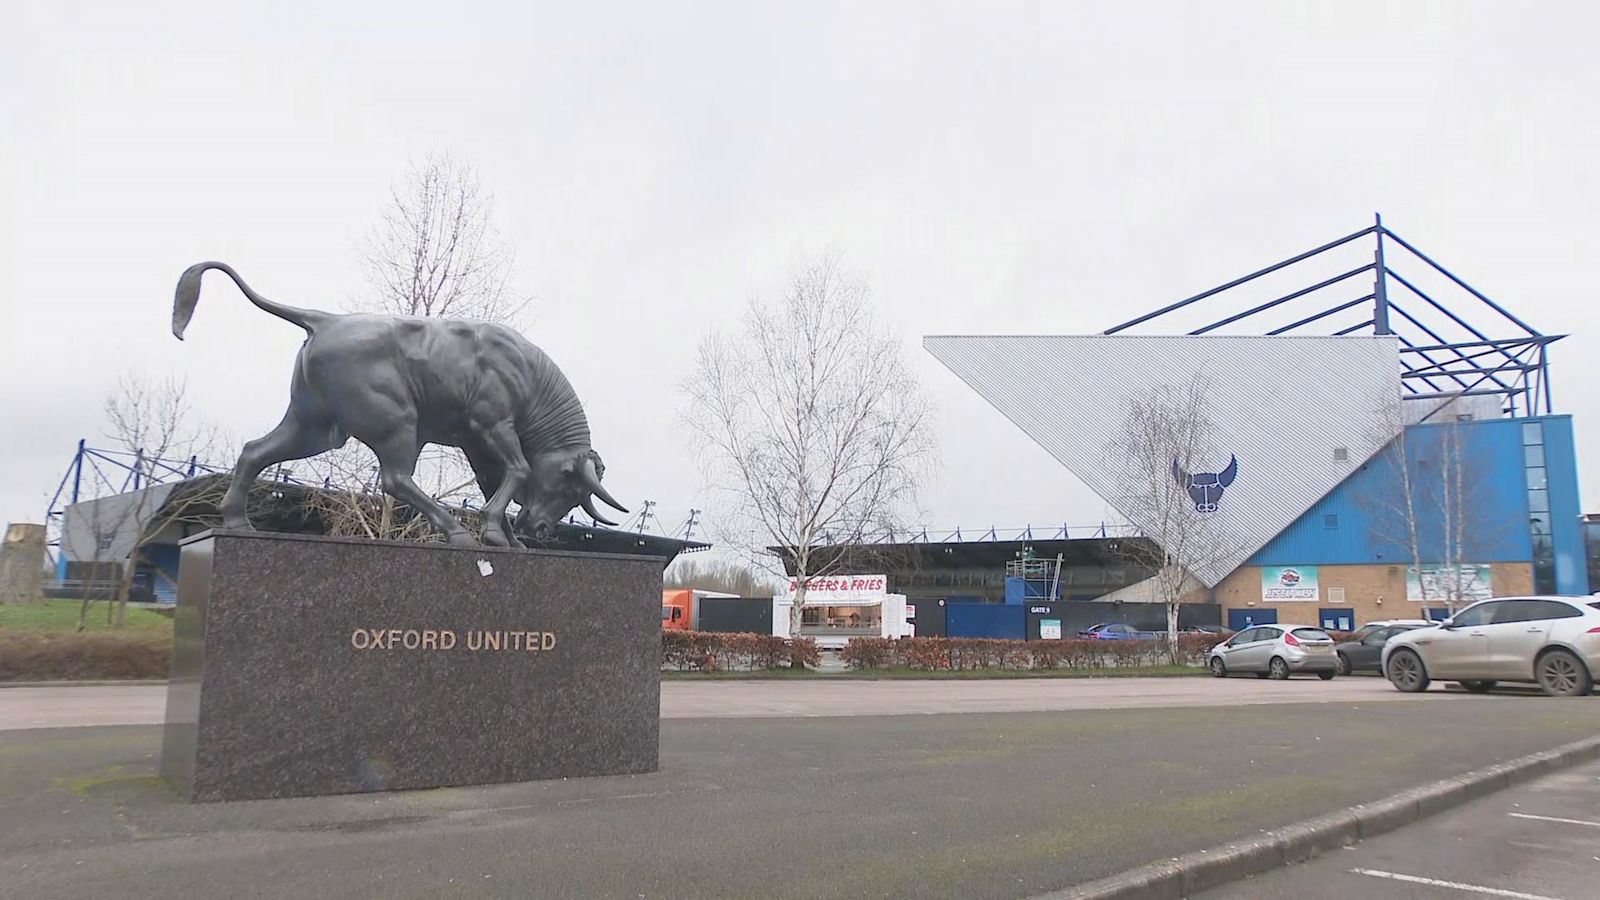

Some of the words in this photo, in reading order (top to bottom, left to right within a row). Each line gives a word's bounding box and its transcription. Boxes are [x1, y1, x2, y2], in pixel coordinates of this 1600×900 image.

[790, 579, 839, 592] BRGERS
[840, 580, 848, 591] &
[851, 579, 883, 591] FRIES
[1031, 606, 1045, 614] GATE
[351, 628, 456, 650] OXFORD
[467, 630, 556, 651] UNITED
